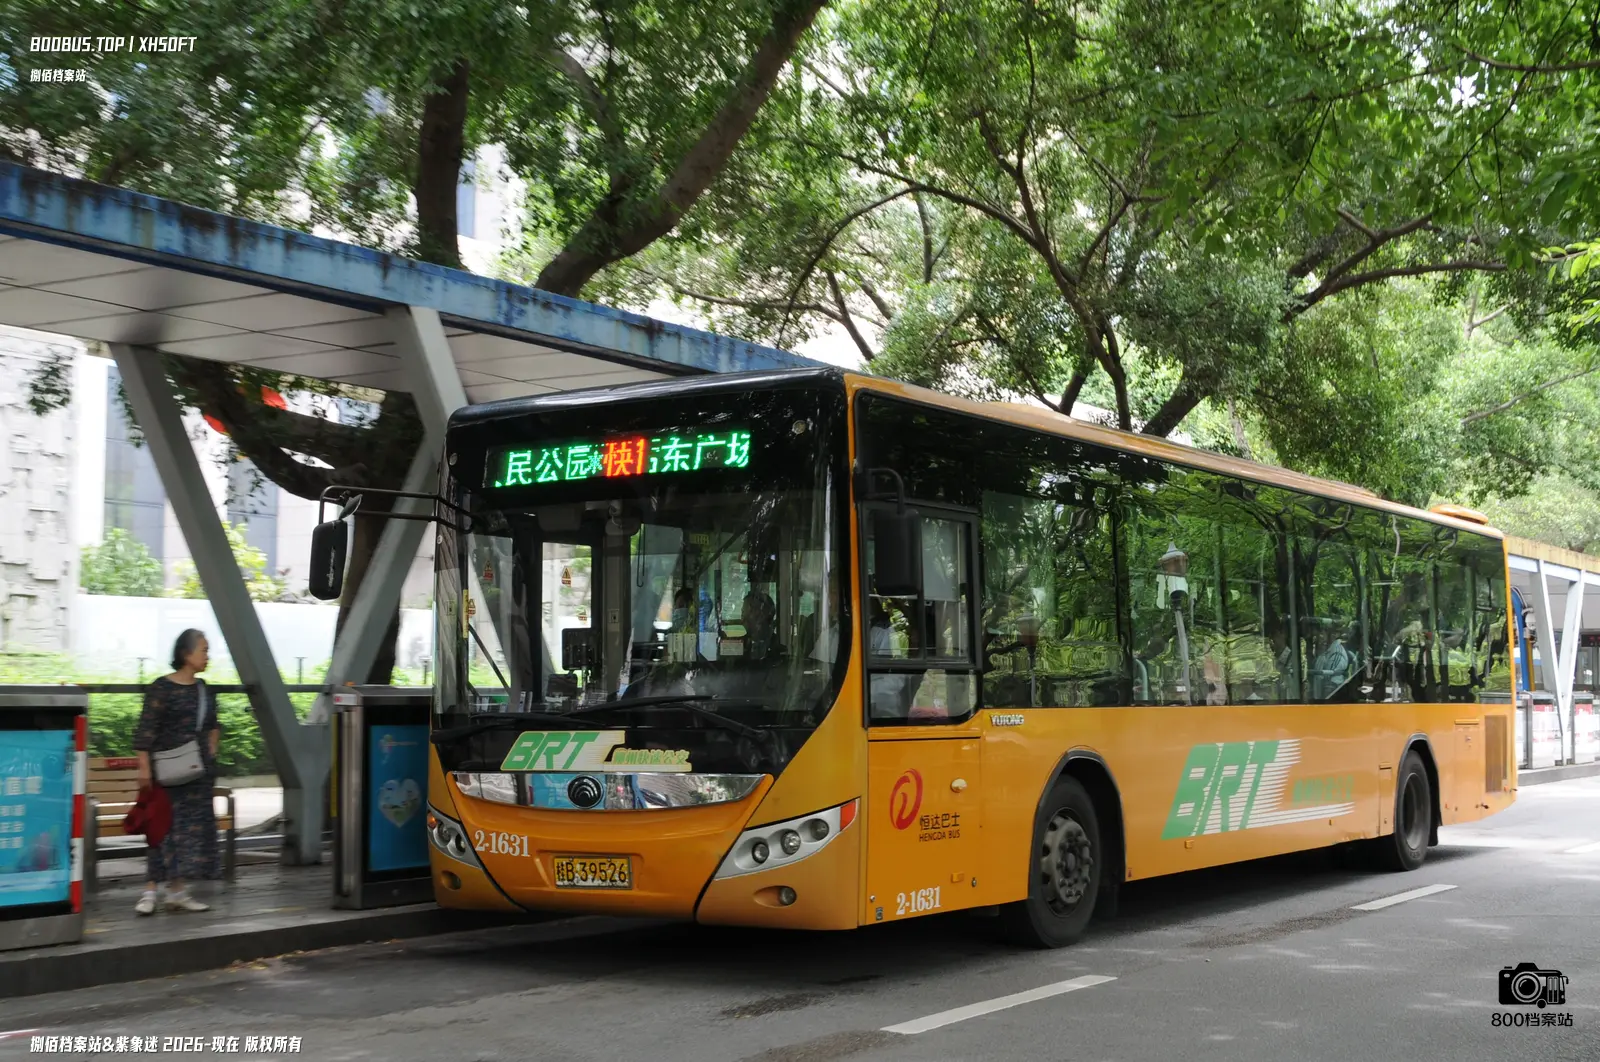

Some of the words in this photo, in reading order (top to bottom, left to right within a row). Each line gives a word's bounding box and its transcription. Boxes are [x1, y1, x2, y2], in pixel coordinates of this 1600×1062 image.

[495, 445, 590, 487] 民公园
[990, 713, 1025, 726] YUTONG
[502, 731, 599, 770] BRT
[1161, 739, 1281, 841] BRT
[919, 811, 961, 831] 恒达巴士
[919, 831, 947, 842] HENGDA
[948, 829, 961, 839] BUS
